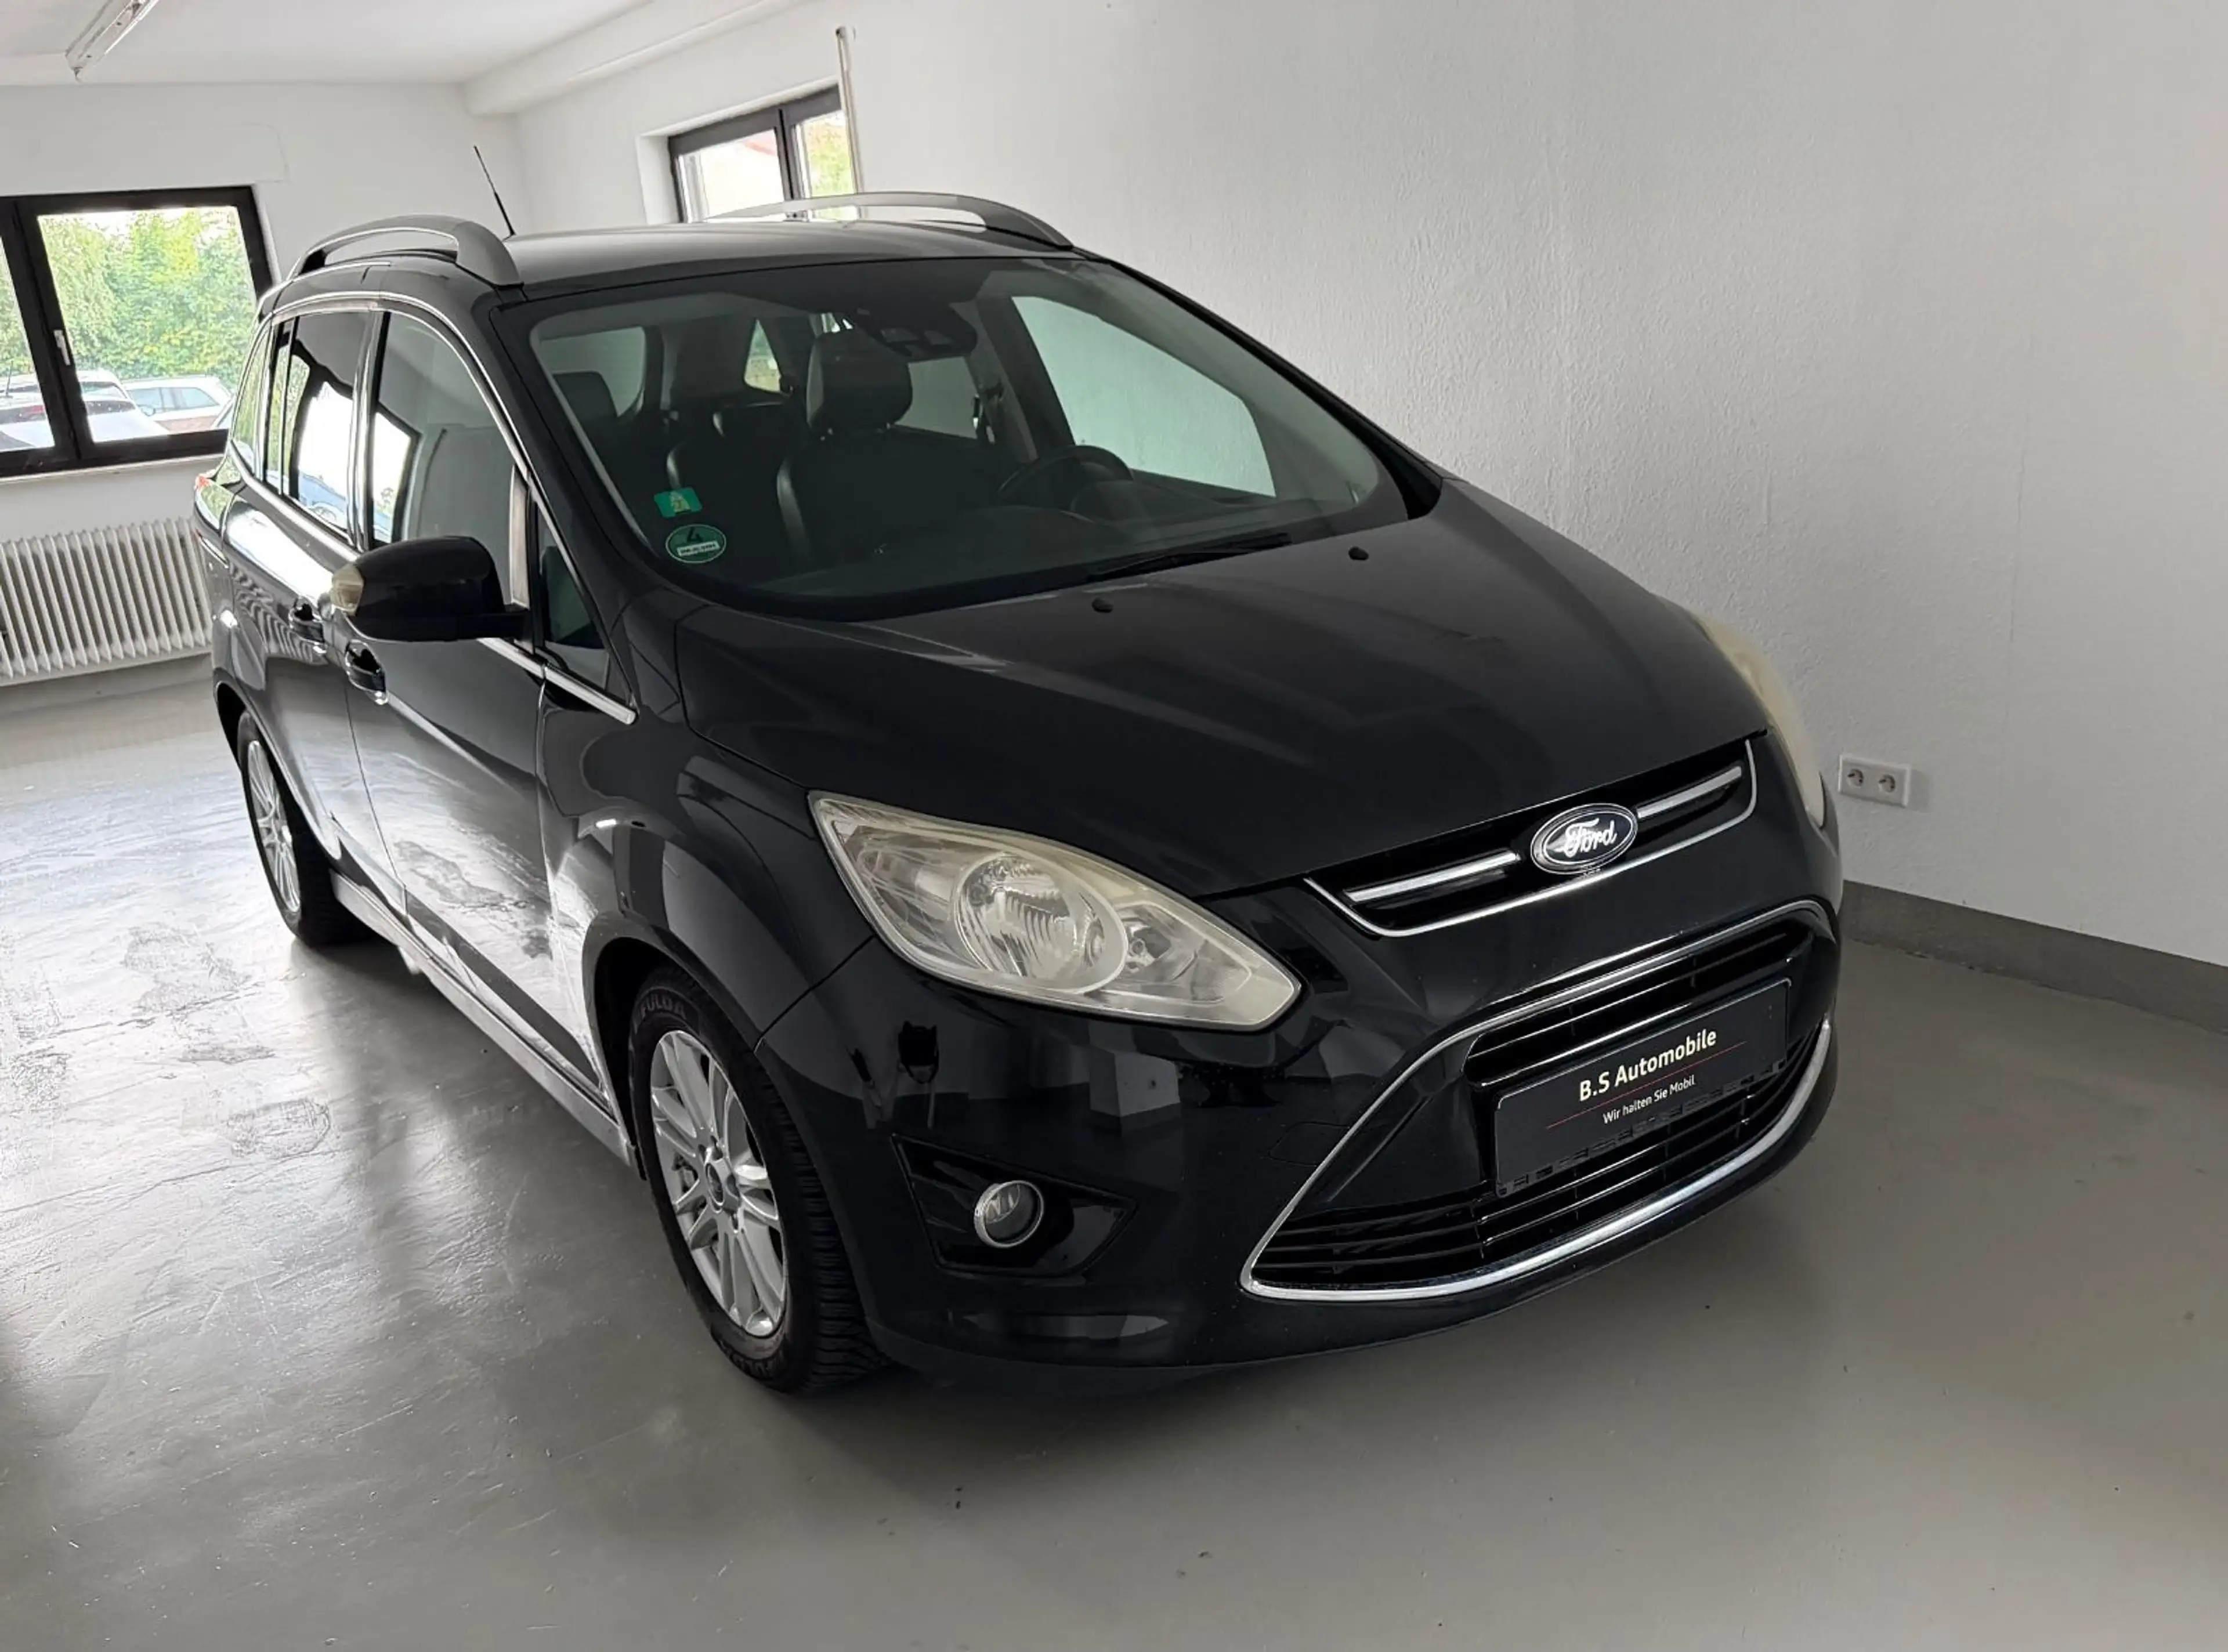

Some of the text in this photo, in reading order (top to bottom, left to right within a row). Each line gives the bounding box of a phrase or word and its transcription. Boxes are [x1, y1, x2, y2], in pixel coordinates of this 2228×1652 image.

[1553, 817, 1618, 858] Ford
[639, 992, 688, 1020] FULDA
[1579, 1027, 1717, 1102] B.S Automobile
[1602, 1074, 1696, 1125] Wir halten Sie Mobil
